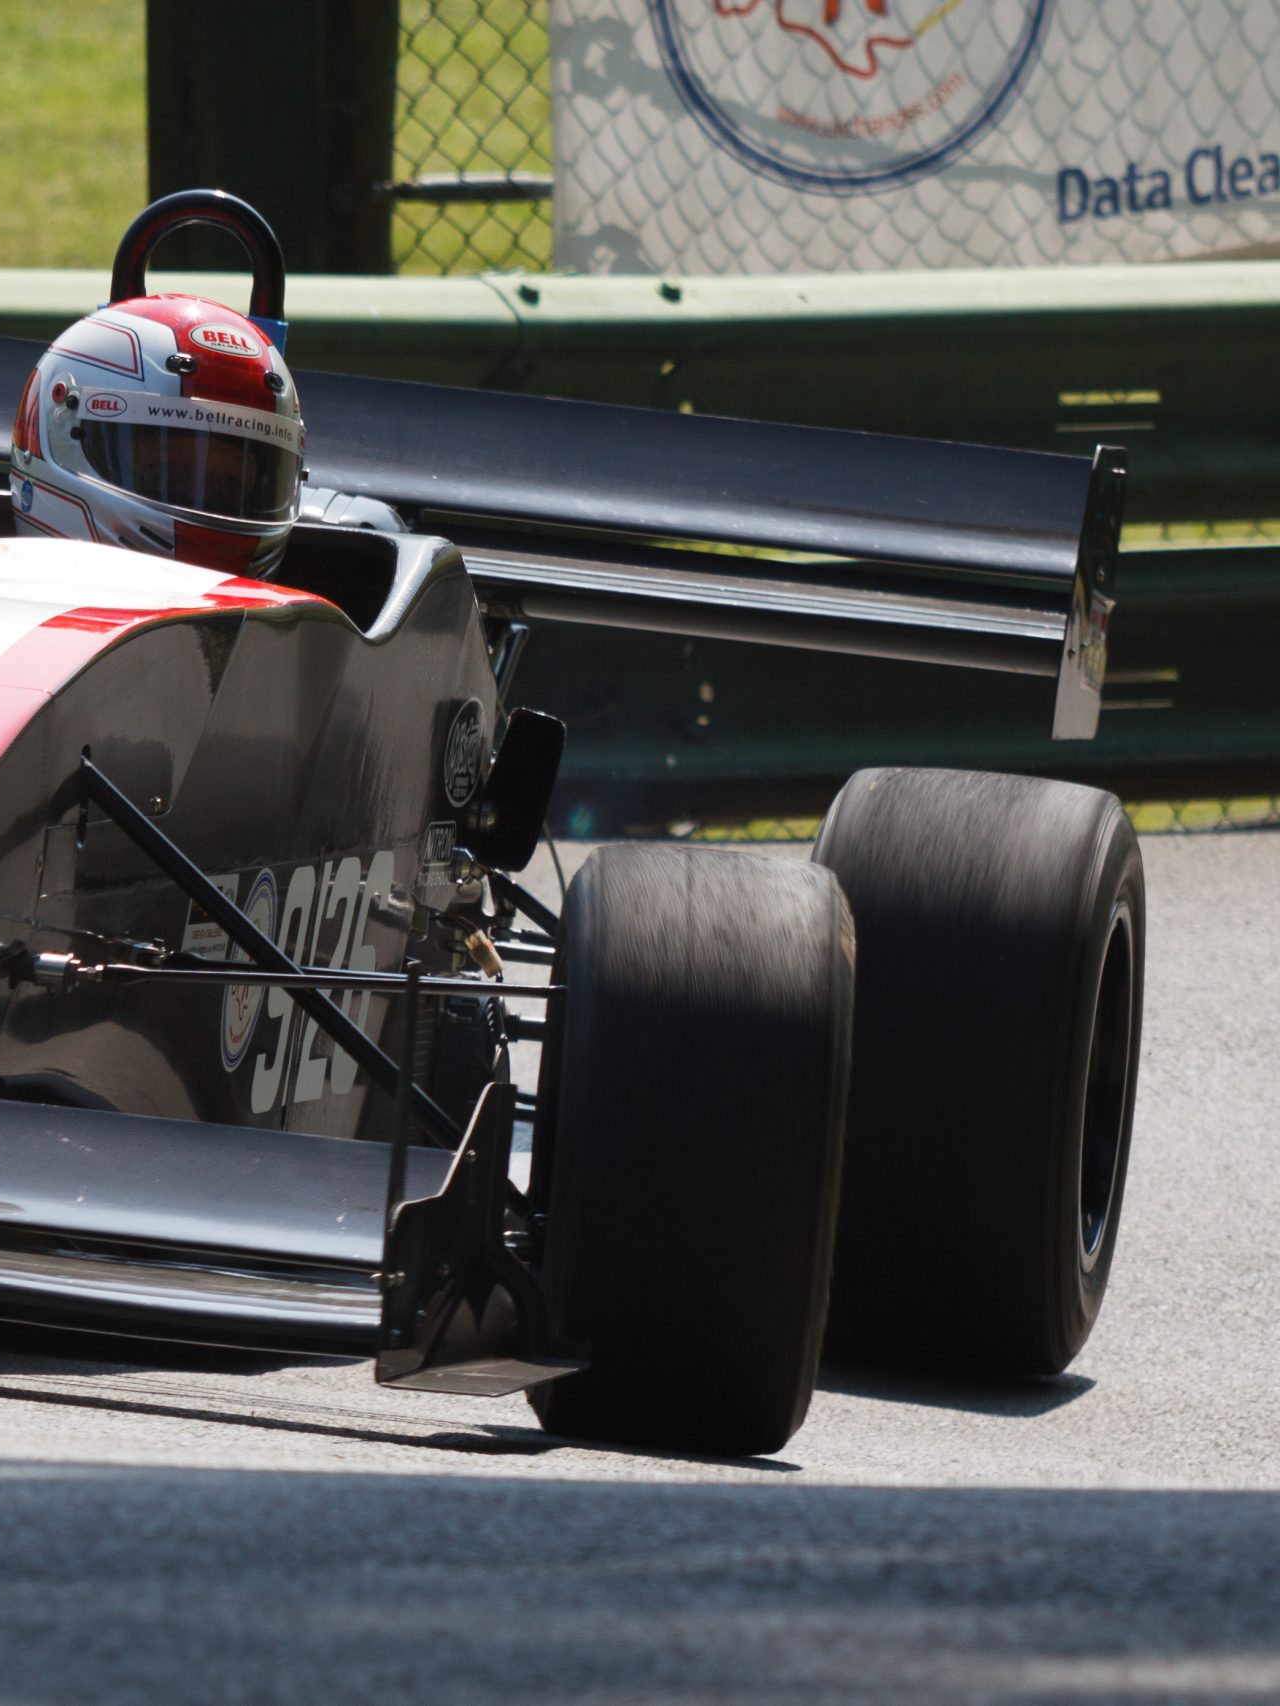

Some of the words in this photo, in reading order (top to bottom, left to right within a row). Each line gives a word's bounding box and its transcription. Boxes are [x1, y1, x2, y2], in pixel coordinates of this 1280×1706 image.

[1056, 161, 1172, 224] Data
[1184, 144, 1280, 206] Clea
[202, 330, 252, 350] BELL
[91, 399, 121, 412] BELL
